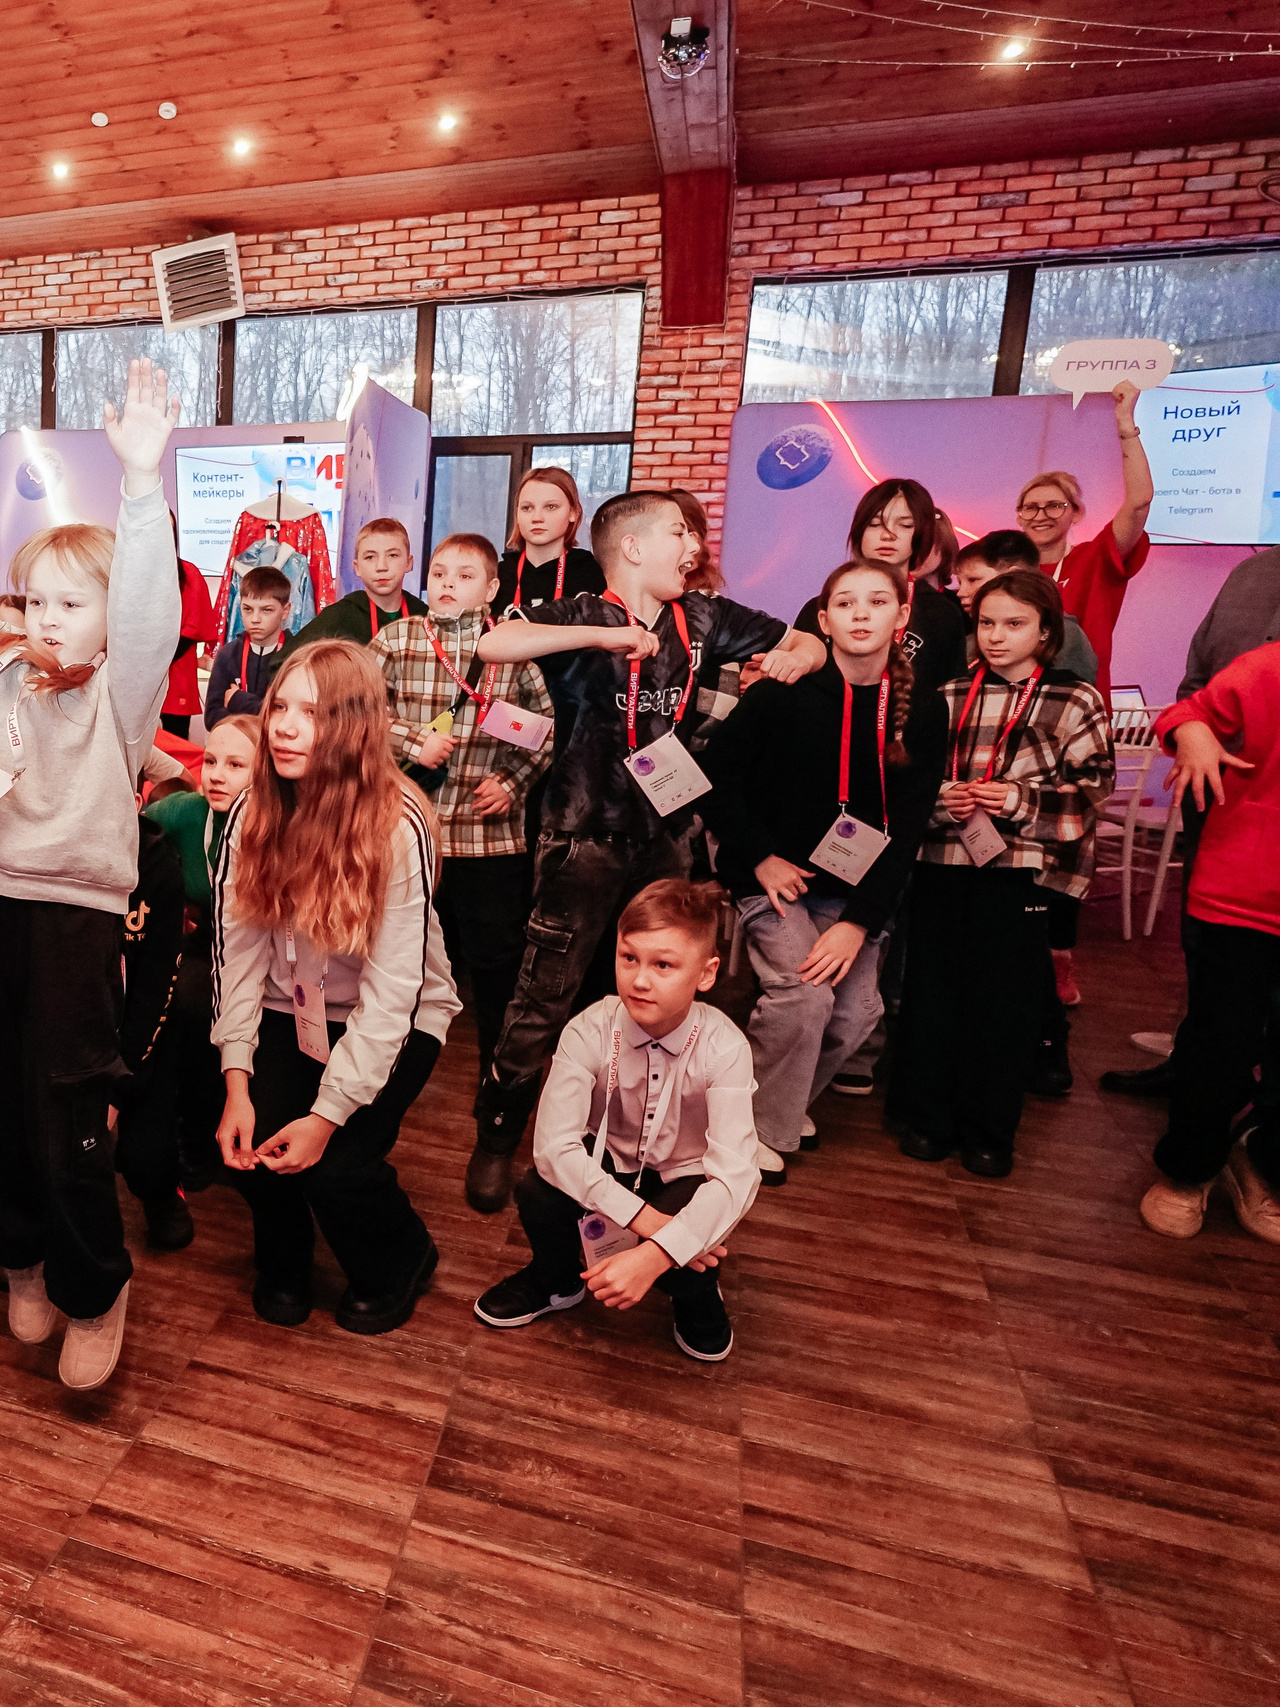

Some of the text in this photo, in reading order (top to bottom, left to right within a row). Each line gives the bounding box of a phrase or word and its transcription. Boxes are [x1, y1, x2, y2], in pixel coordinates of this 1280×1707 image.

[1065, 359, 1157, 371] ГРУППА 3
[1163, 400, 1241, 420] Новый
[1172, 426, 1227, 443] друг
[192, 472, 244, 483] Контент-
[1171, 468, 1216, 477] Создаем
[192, 487, 245, 500] мейкеры
[1182, 487, 1200, 496] Чат
[1168, 506, 1214, 516] Telegram
[628, 672, 638, 729] ВИРТУАЛИТИ
[877, 678, 889, 730] ВИРТУАЛИТИ
